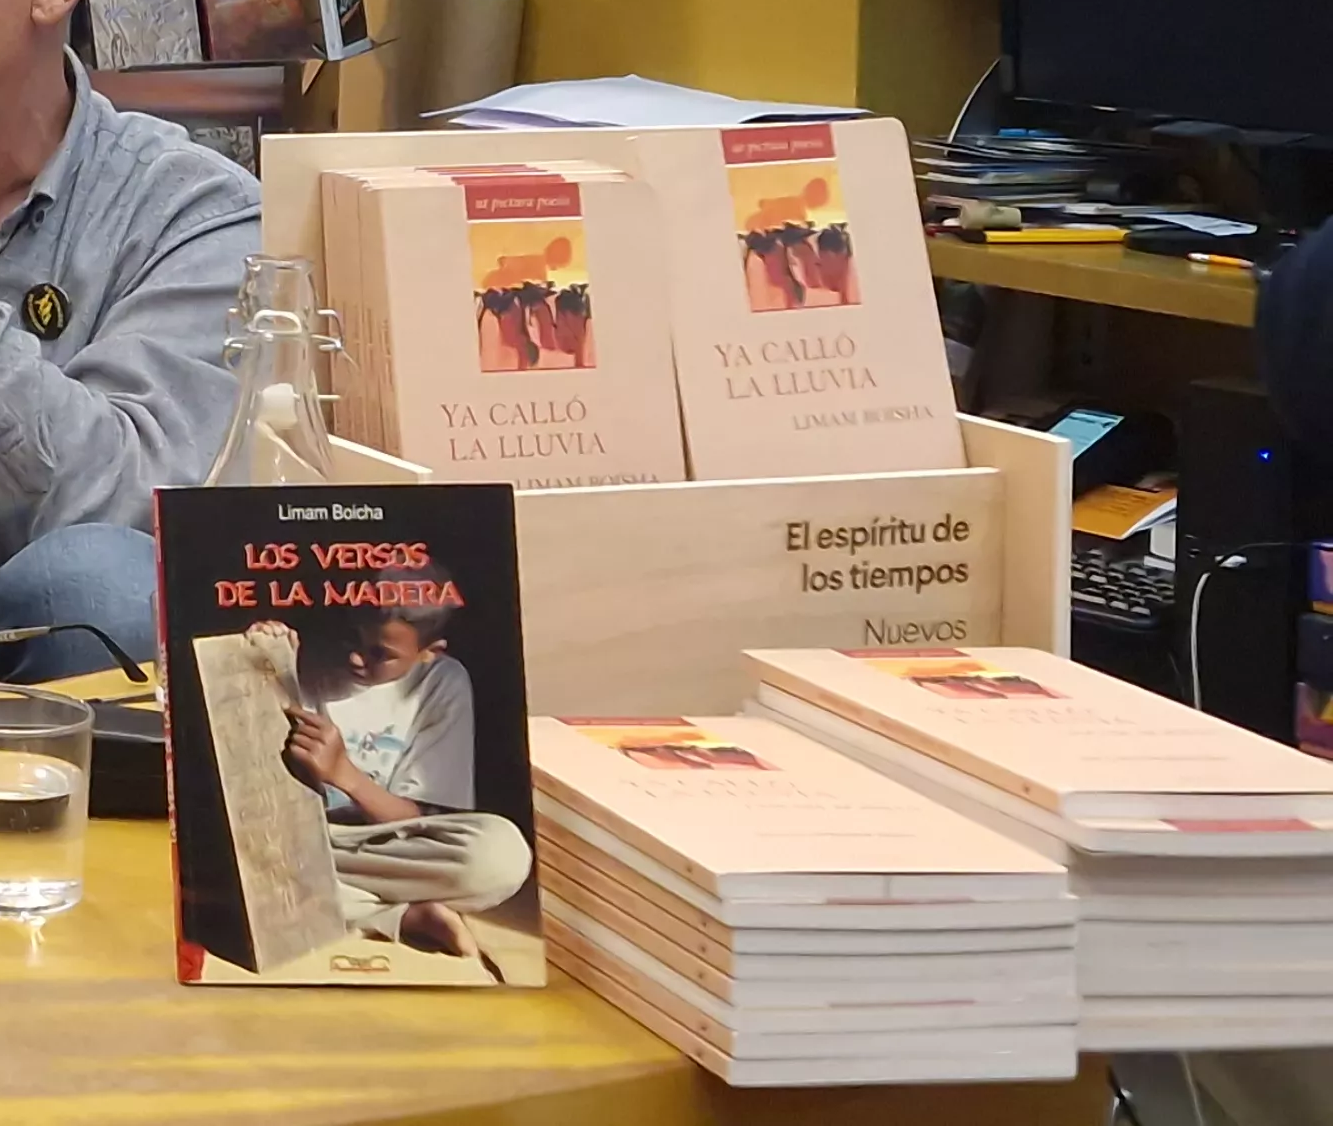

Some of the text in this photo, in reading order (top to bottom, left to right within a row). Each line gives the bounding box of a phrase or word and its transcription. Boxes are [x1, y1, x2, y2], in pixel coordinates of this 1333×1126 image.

[714, 331, 856, 368] YA CALLÓ
[725, 366, 878, 400] LA LLUVIA
[440, 393, 587, 428] YA CALLÓ
[449, 431, 607, 461] LA LLUVIA
[277, 503, 328, 521] Limam
[786, 513, 970, 556] El espíritu de
[244, 542, 431, 570] LOS VERSOS
[801, 560, 969, 594] los tiempos
[214, 580, 466, 608] DE LA MADERA
[864, 617, 968, 647] Nuevos
